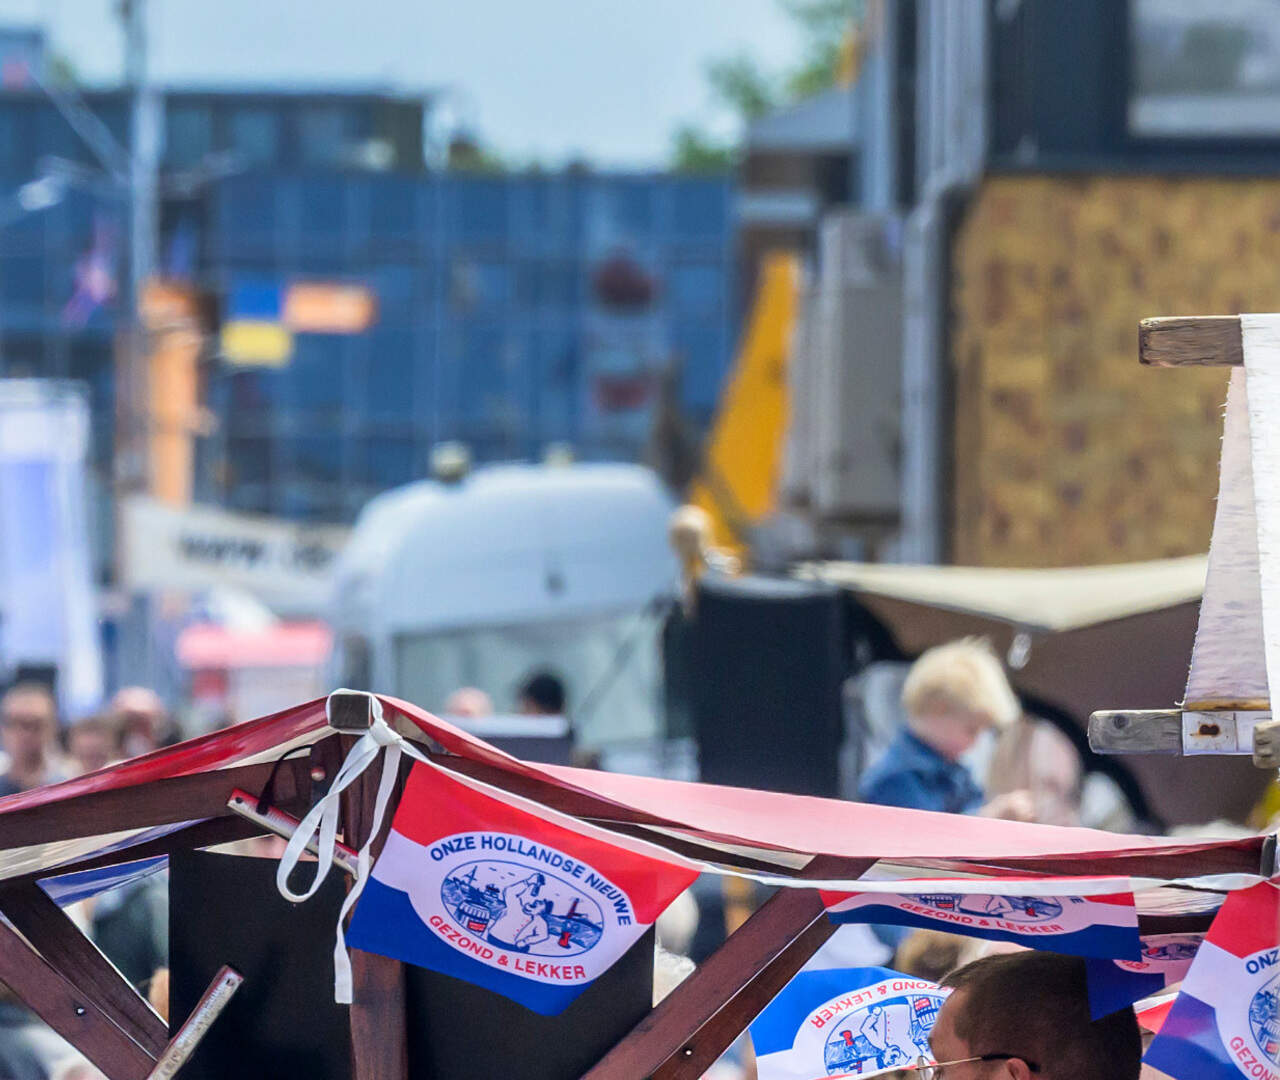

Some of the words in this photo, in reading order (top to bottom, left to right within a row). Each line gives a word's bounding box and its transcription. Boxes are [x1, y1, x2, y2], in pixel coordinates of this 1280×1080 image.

[430, 836, 477, 862] ONZE
[481, 835, 585, 879] HOLLANDSE
[586, 872, 632, 926] NIEUWE
[900, 903, 973, 924] GEZOND
[996, 920, 1065, 933] LEKKER
[429, 915, 494, 960] GEZOND
[497, 954, 509, 966] &
[515, 958, 587, 981] LEKKER
[1246, 949, 1280, 975] ONZ
[876, 985, 888, 995] &
[893, 981, 943, 991] ZOND
[811, 990, 873, 1029] LEKKER
